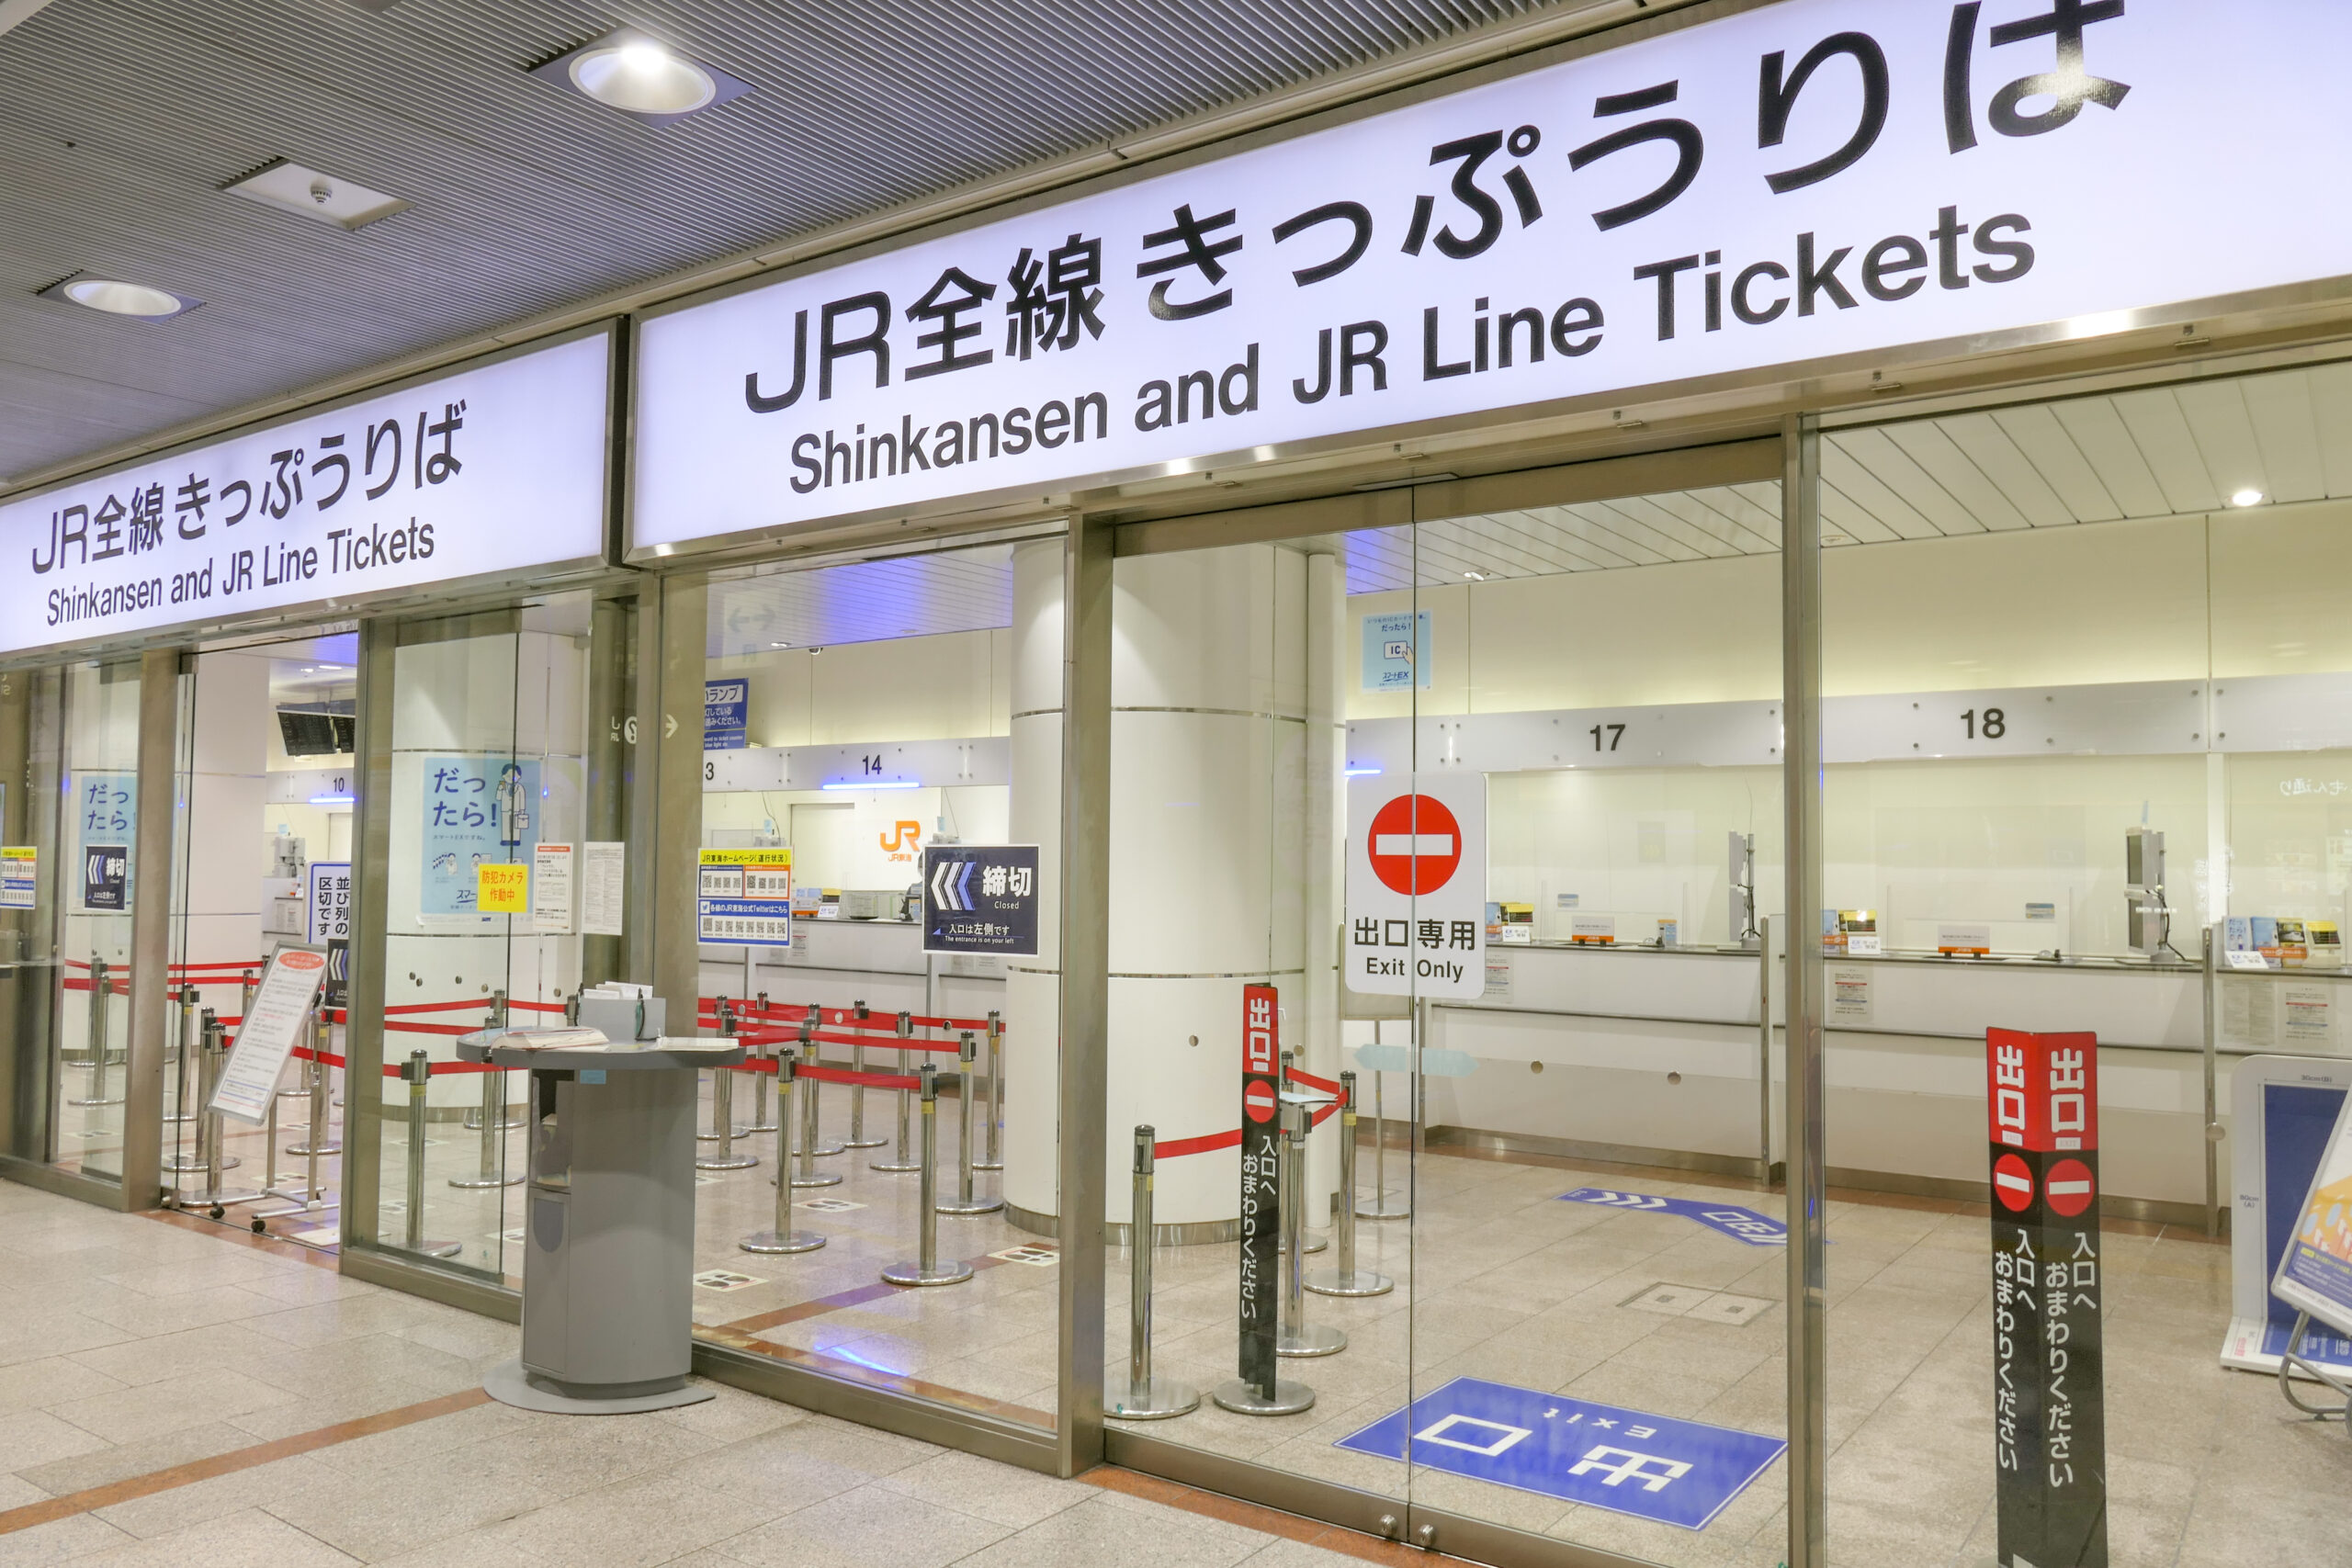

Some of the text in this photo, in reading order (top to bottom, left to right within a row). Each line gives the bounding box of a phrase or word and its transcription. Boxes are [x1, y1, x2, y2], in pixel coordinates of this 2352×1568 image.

[790, 206, 2036, 494] Shinkansen and JR Line Tickets
[32, 399, 467, 574] JR全線きっぷうりば
[47, 516, 434, 626] Shinkansen and JR Line Tickets
[1391, 645, 1401, 655] IC
[1589, 723, 1626, 751] 17
[1960, 707, 2006, 739] 18
[434, 767, 486, 793] だっ
[862, 754, 882, 775] 14
[88, 784, 129, 804] だっ
[333, 777, 345, 792] 10
[433, 801, 497, 827] たら!
[879, 820, 922, 852] JR
[481, 870, 524, 885] 防犯カメラ
[982, 865, 1032, 897] 締切
[318, 876, 332, 935] 区切です
[335, 876, 349, 935] 並び列の
[490, 888, 514, 902] 作動中
[994, 901, 1020, 909] Closed
[949, 922, 1010, 936] 入口は左側です
[1354, 917, 1476, 951] 出口専用
[1366, 957, 1405, 976] Exit
[1416, 959, 1464, 984] Only
[1250, 997, 1271, 1062] 出口
[1996, 1043, 2026, 1131] 出口
[2049, 1047, 2086, 1133] 出口
[1261, 1134, 1276, 1195] 入口へ
[1241, 1154, 1259, 1319] おまわりください
[2015, 1228, 2036, 1311] 入口へ
[2072, 1232, 2097, 1310] 入口へ
[1995, 1250, 2018, 1472] おまわりください
[2046, 1261, 2074, 1488] おまわりください
[1543, 1407, 1657, 1439] Exit
[1413, 1413, 1693, 1493] 出口
